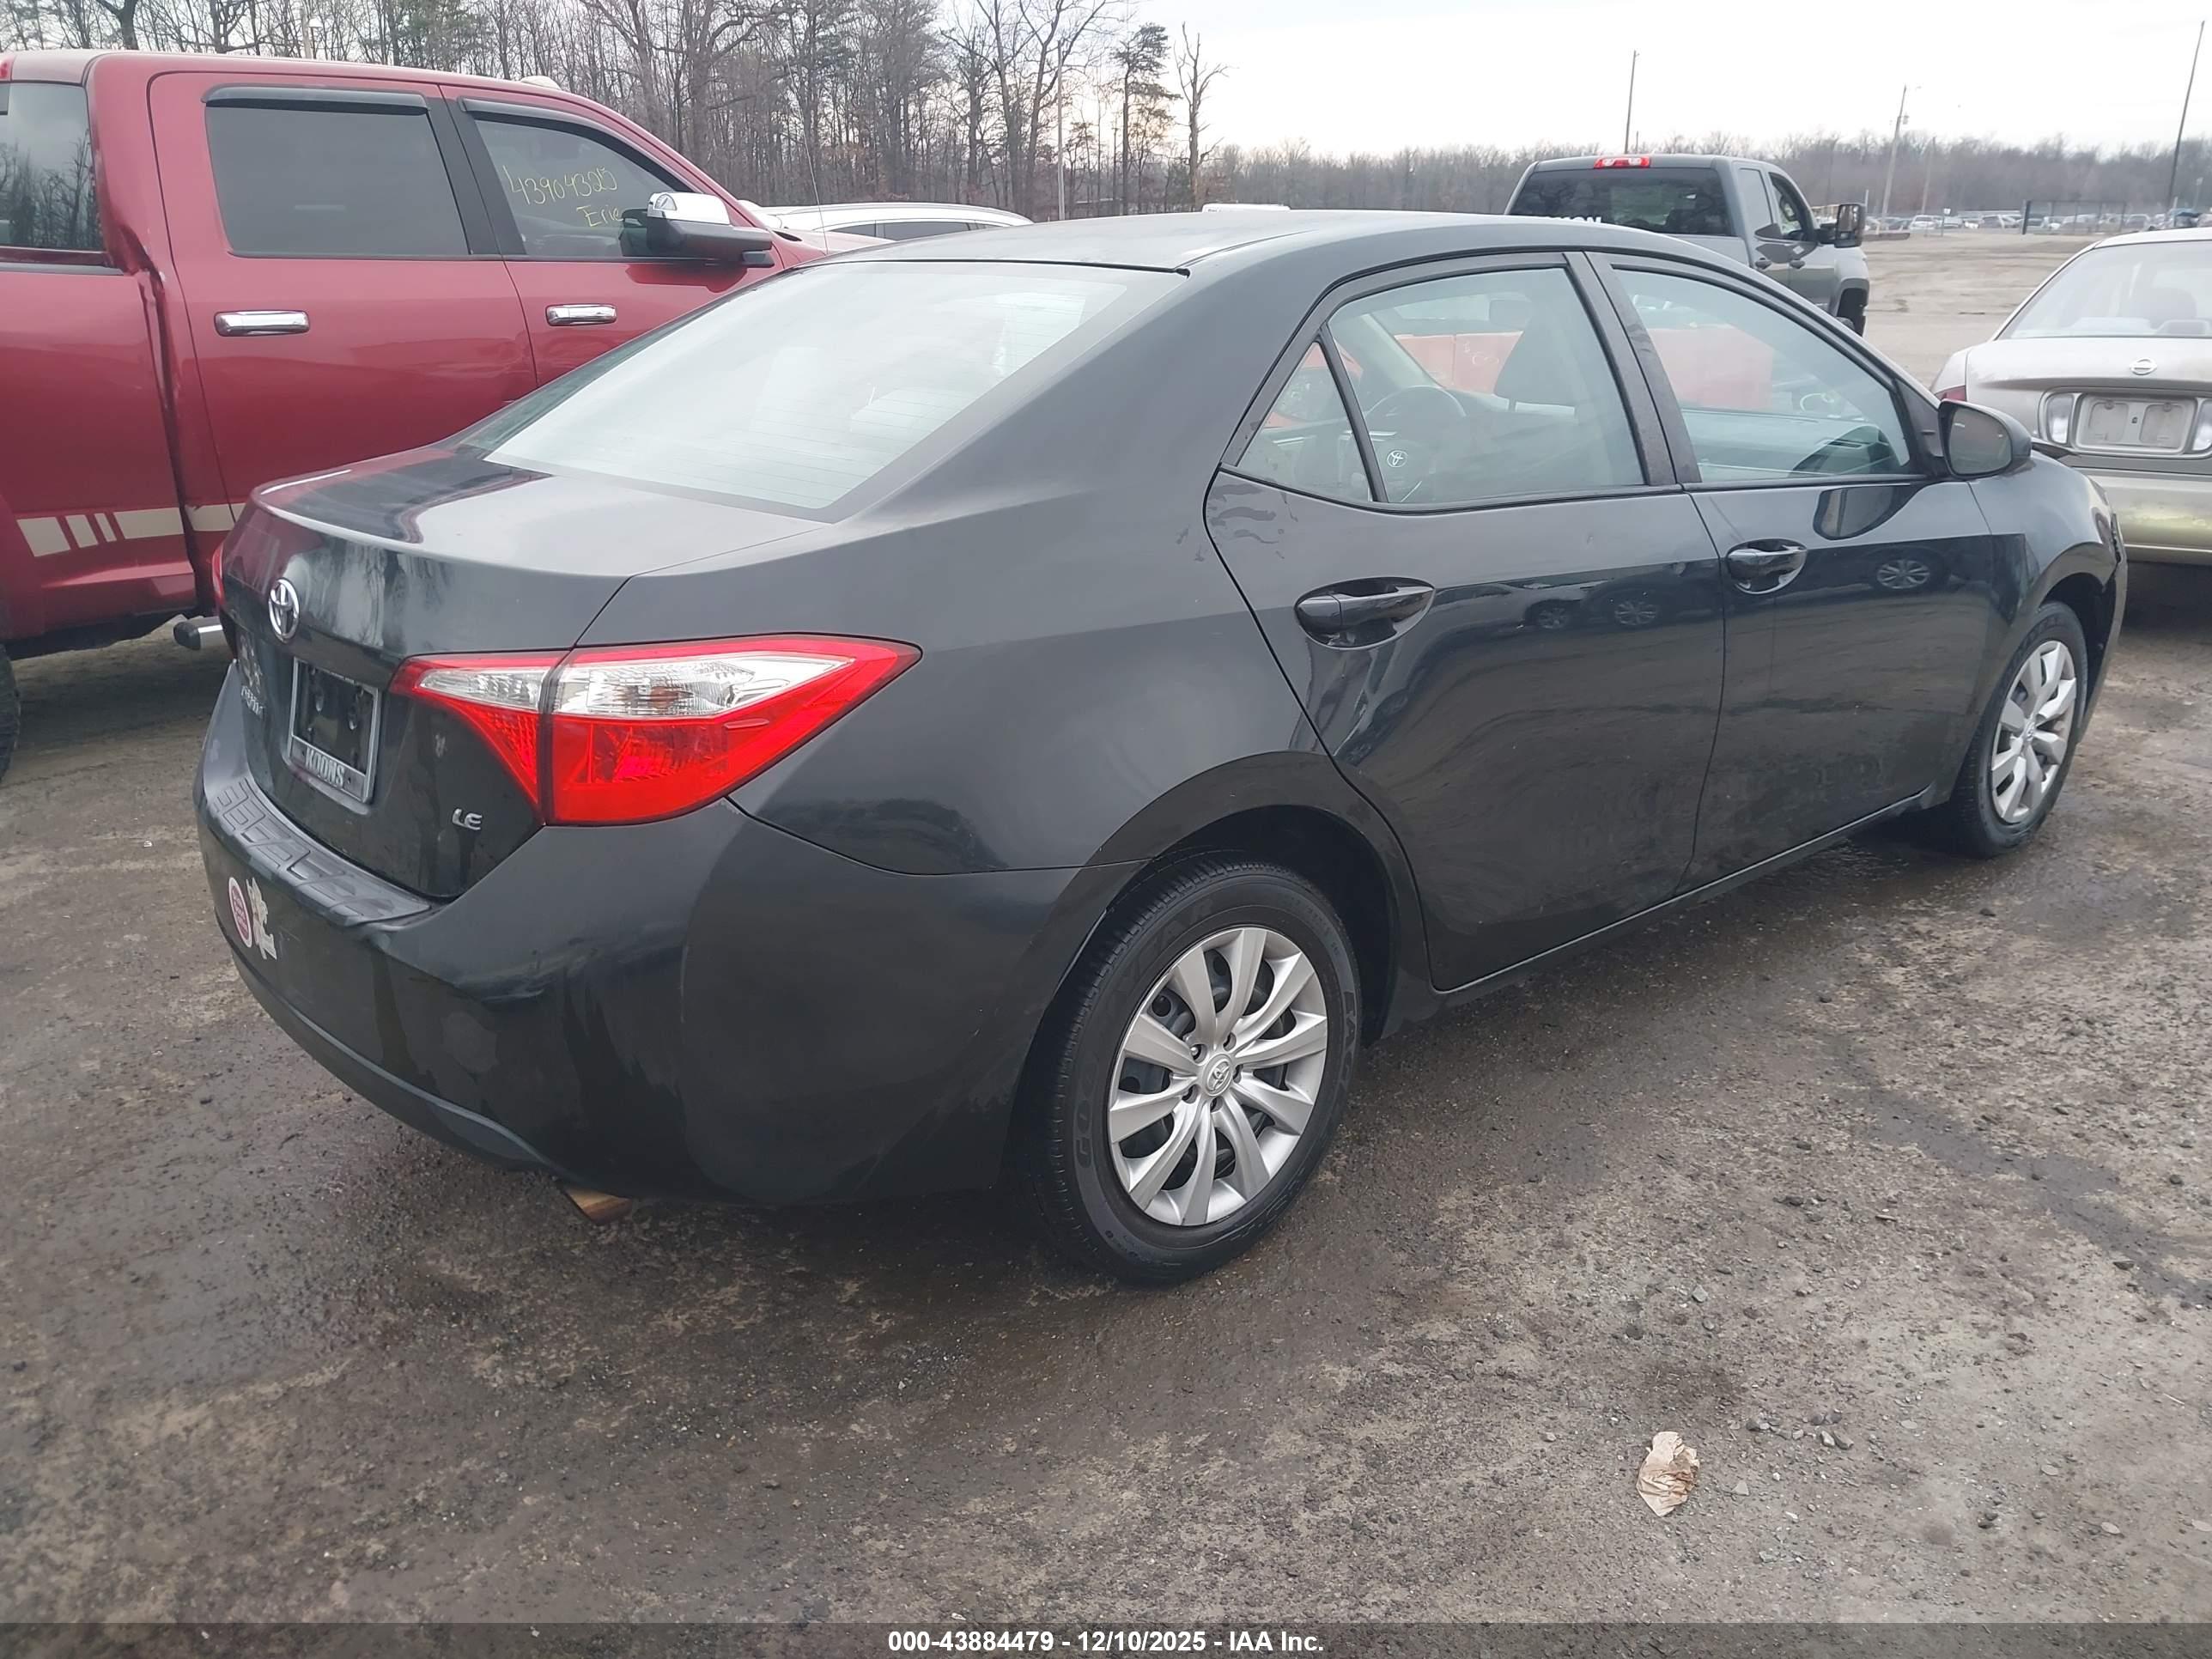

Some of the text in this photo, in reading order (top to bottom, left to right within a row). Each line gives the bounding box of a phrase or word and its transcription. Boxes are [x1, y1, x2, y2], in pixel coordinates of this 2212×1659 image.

[502, 165, 618, 205] 43904325
[305, 746, 345, 788] KOONS
[452, 808, 483, 830] LE
